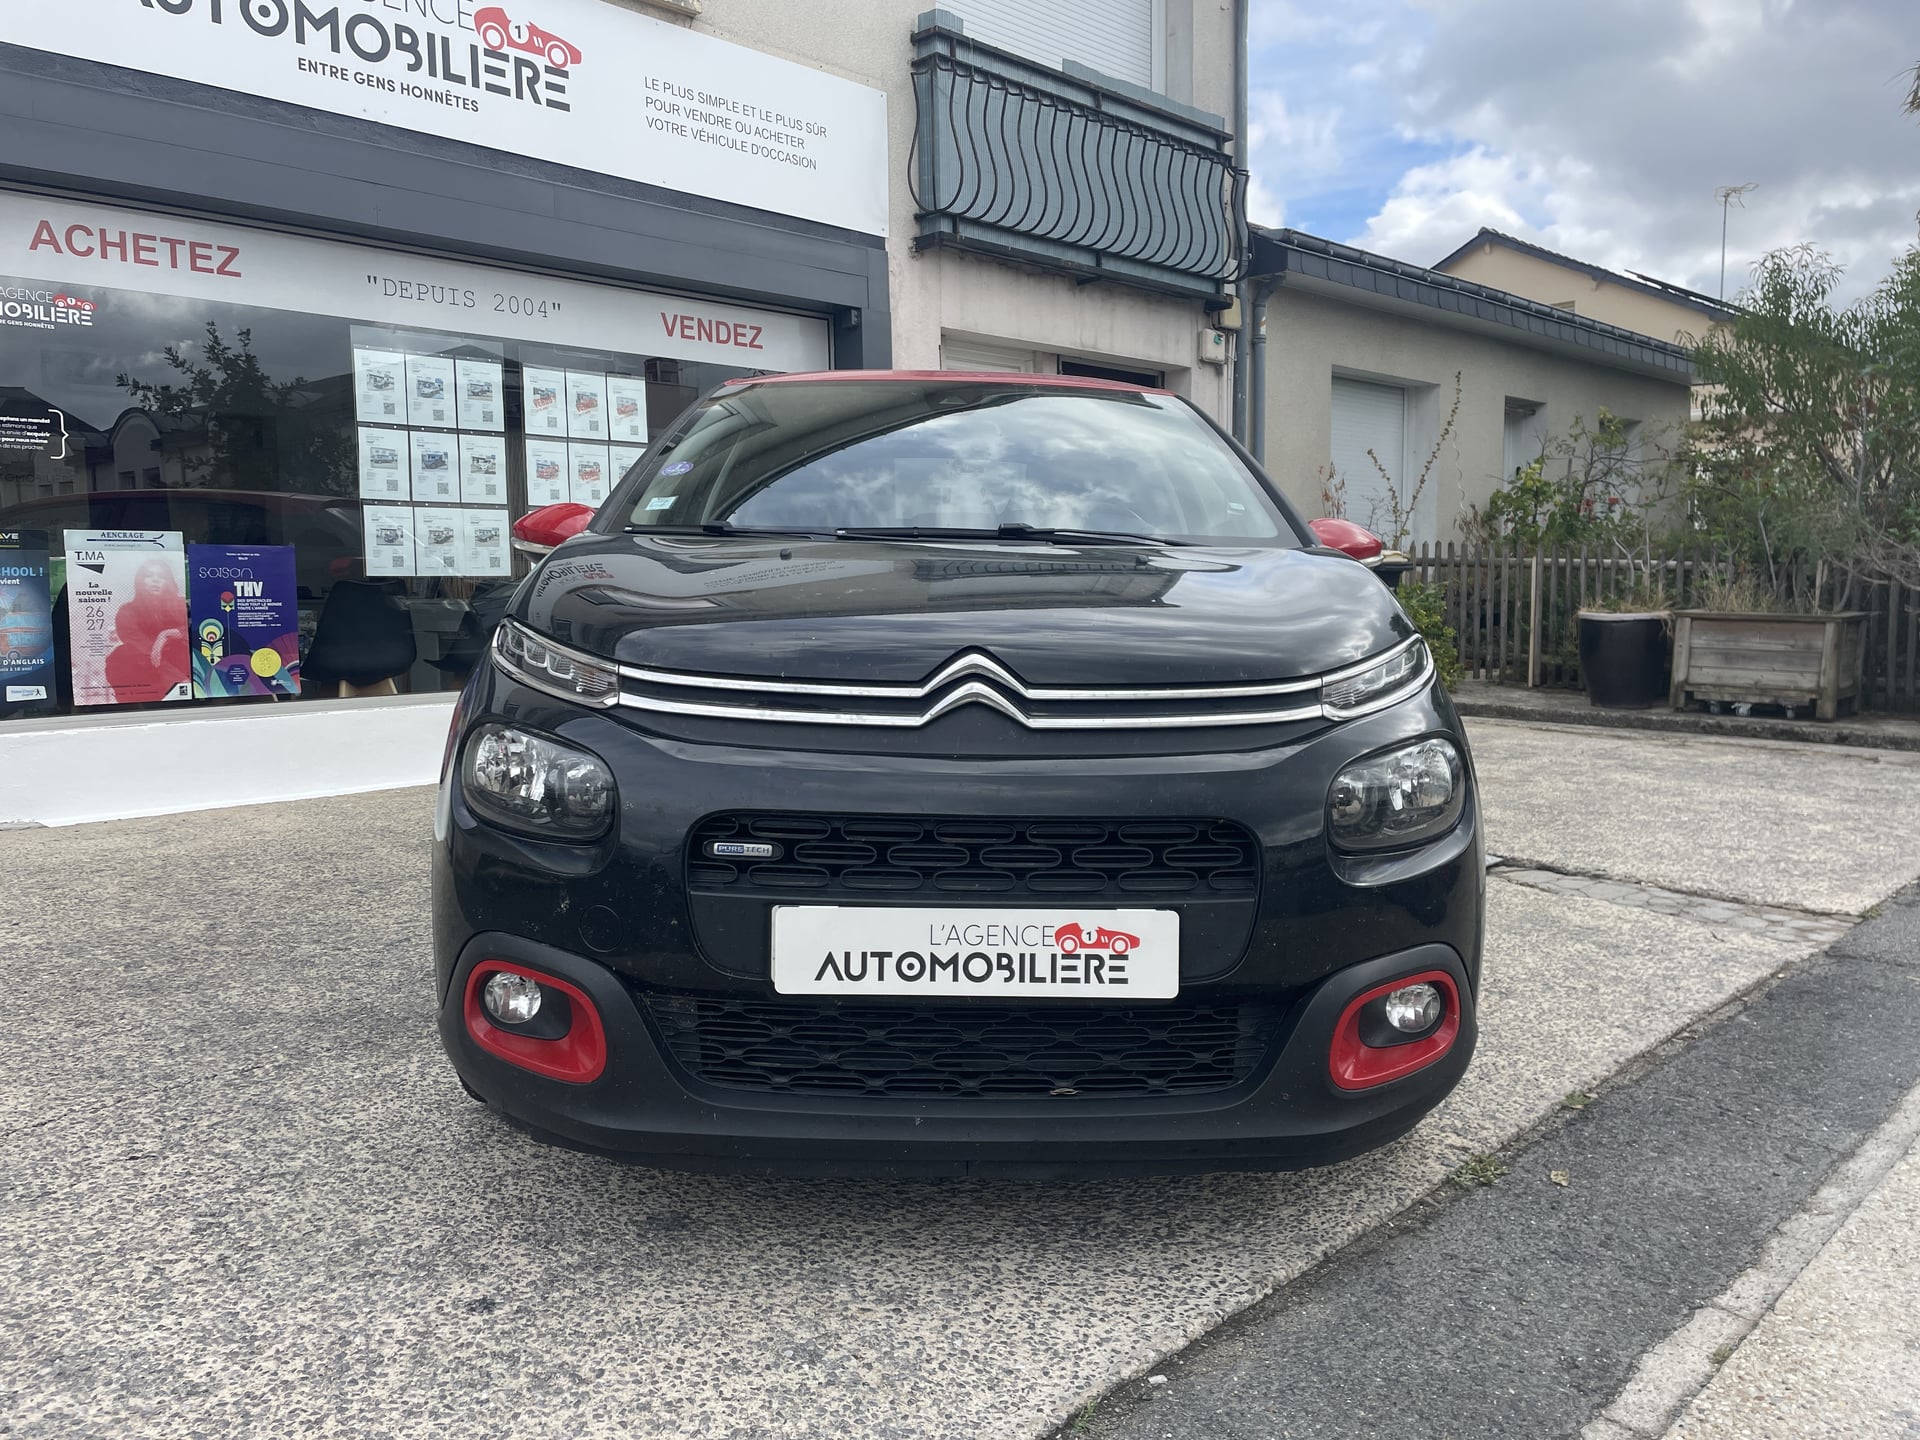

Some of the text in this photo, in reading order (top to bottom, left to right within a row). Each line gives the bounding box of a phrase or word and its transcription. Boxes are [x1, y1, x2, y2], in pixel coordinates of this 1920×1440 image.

[298, 57, 479, 112] ENTRE GENS HONNÊTES
[644, 76, 827, 138] LE PLUS SIMPLE ET LE PLUS SÛR
[645, 96, 805, 149] POUR VENDRE OU ACHETER
[645, 115, 817, 170] VOTRE VÉHICULE D'OCCASION
[29, 220, 242, 278] ACHETEZ
[366, 275, 561, 318] "DEPUIS 2004"
[660, 312, 763, 349] VENDEZ
[100, 531, 145, 539] AENCRAGE
[74, 551, 105, 561] T.MA
[0, 566, 37, 577] HOOL
[234, 581, 264, 597] THV
[78, 596, 107, 604] saison
[85, 605, 105, 618] 26
[86, 619, 105, 631] 27
[3, 658, 45, 666] D'ANGLAIS
[930, 924, 1055, 947] L'AGENCE
